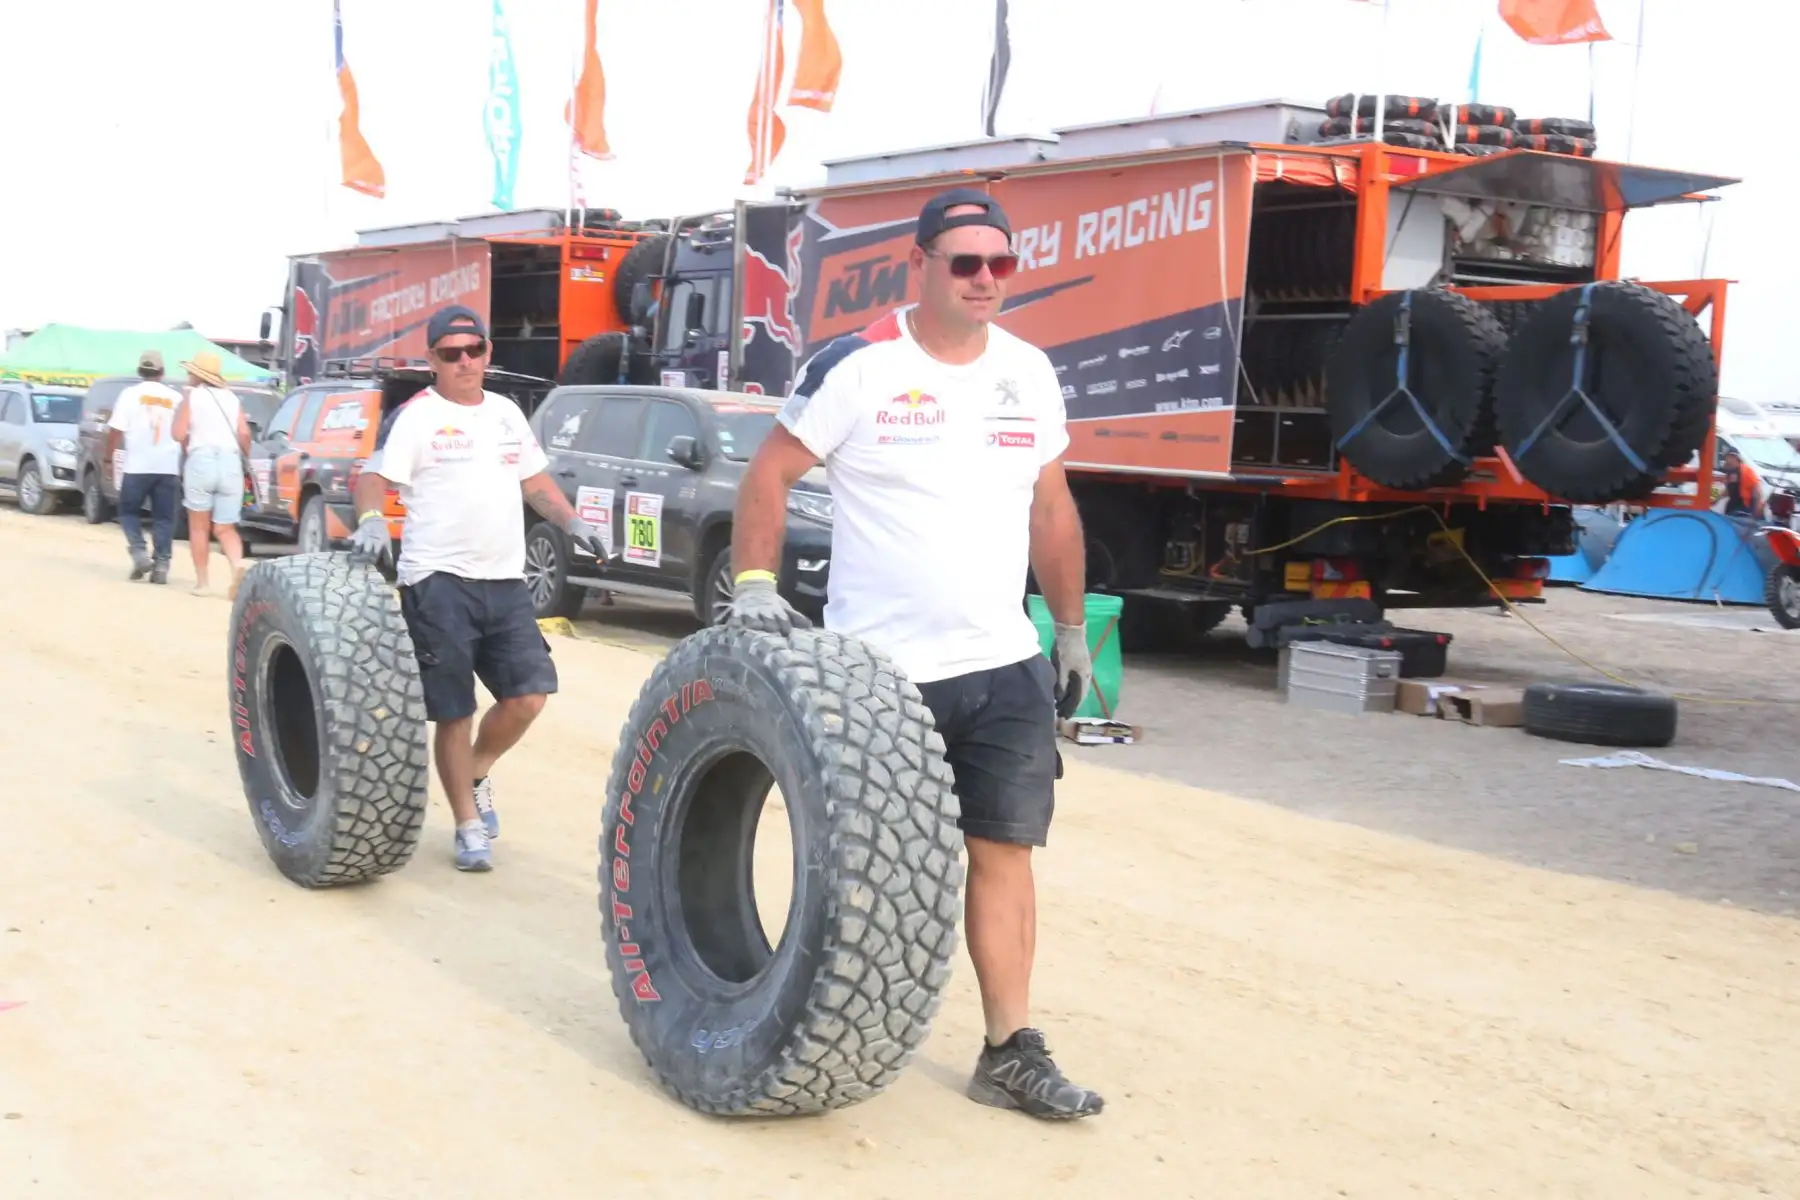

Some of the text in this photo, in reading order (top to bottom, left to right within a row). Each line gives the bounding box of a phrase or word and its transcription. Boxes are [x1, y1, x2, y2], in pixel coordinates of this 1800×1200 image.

[823, 255, 909, 319] KTM
[876, 410, 946, 425] Red Bull
[630, 518, 654, 547] 780
